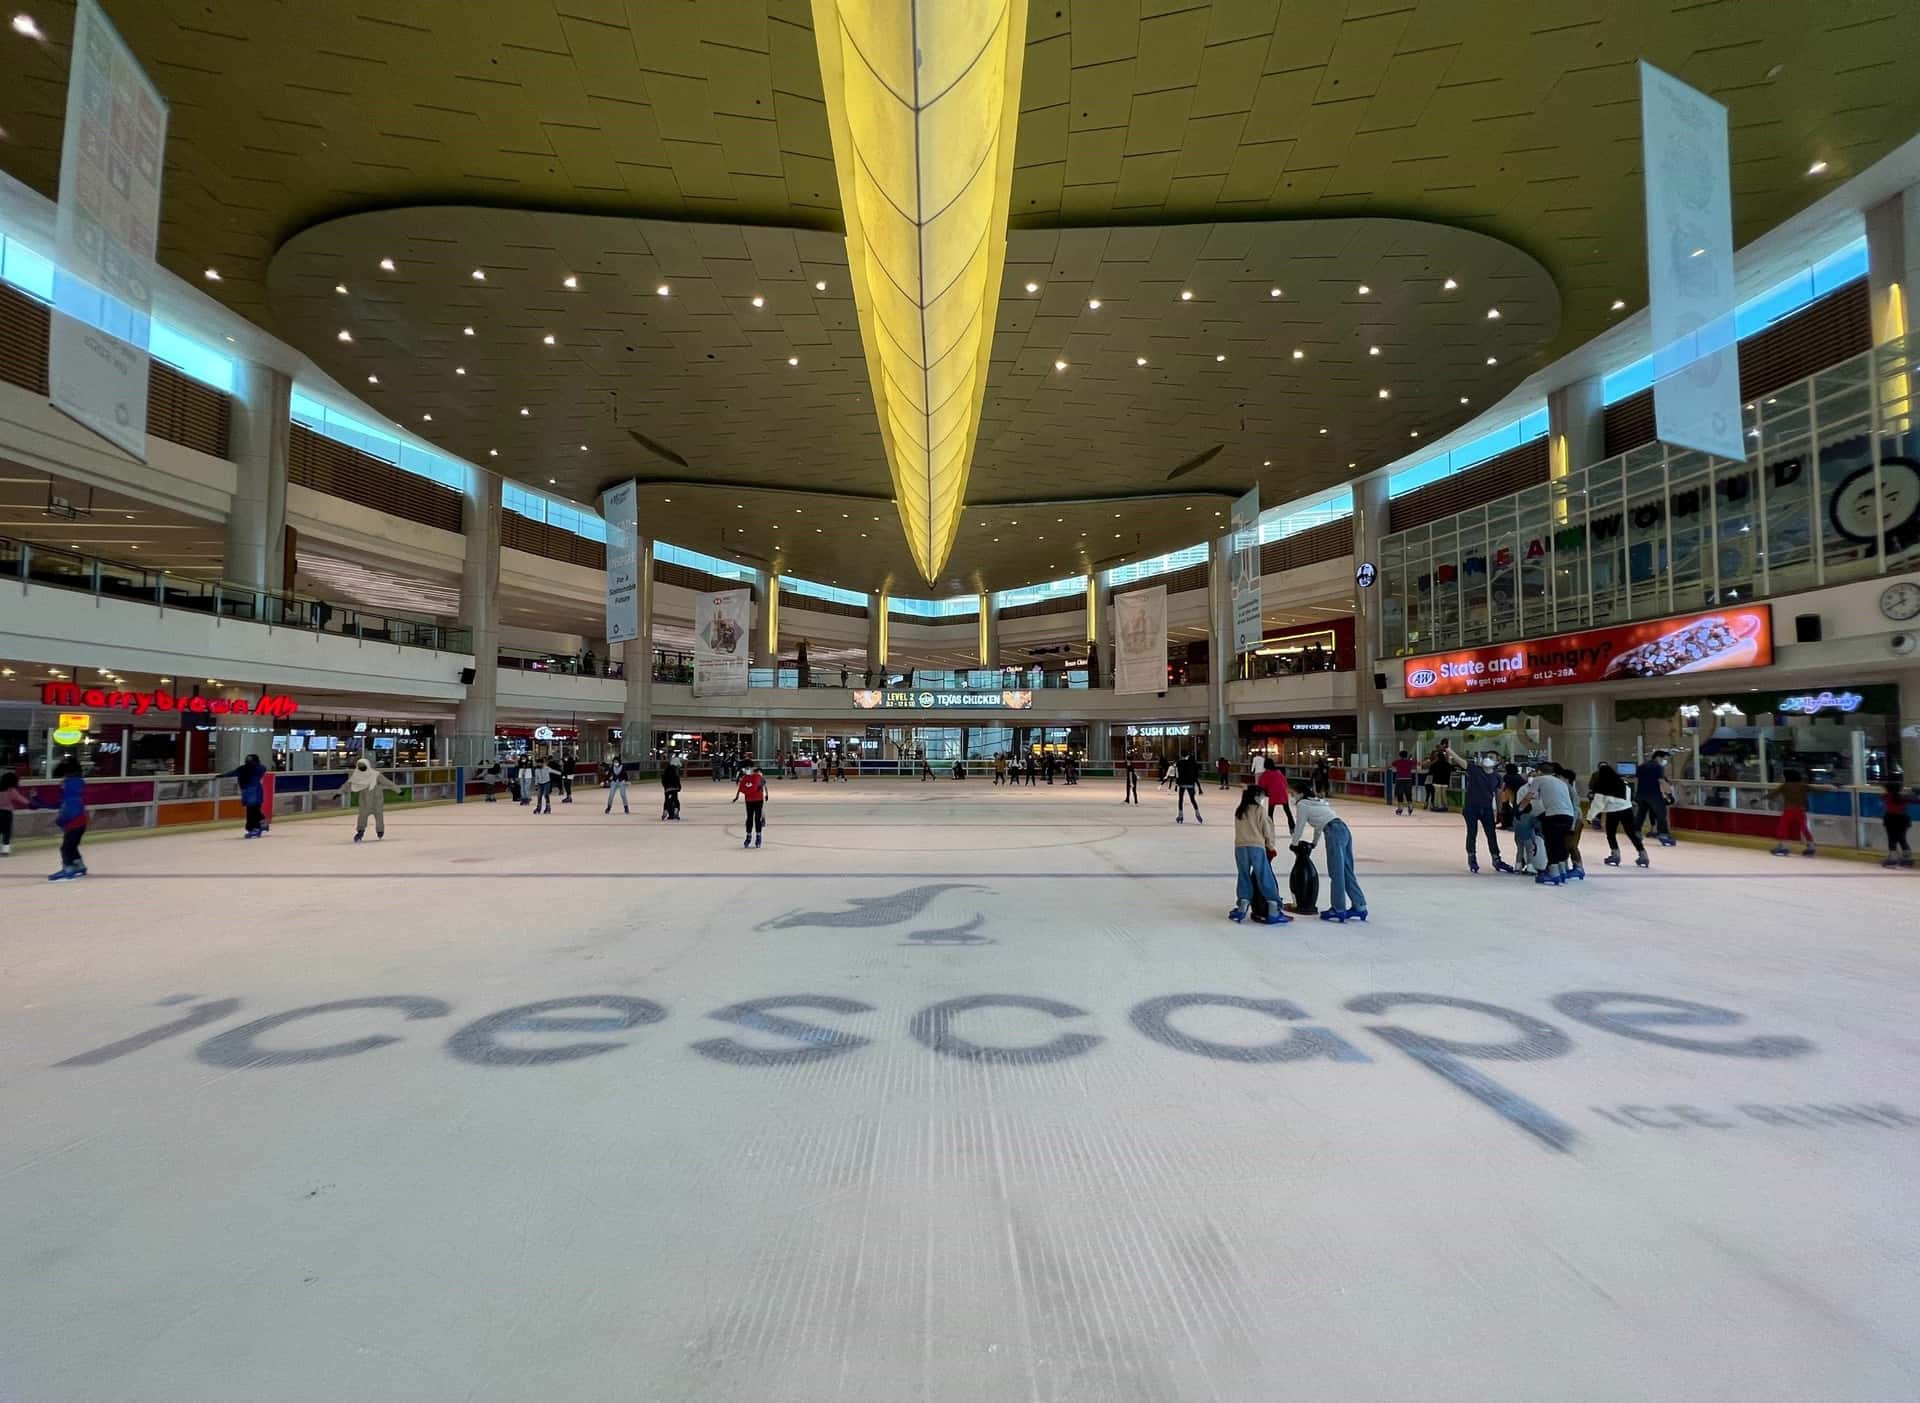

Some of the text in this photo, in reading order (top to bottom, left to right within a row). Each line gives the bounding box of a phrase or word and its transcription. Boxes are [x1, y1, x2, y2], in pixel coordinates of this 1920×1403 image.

[1440, 641, 1613, 678] Skate and hungry?
[887, 692, 908, 701] LEVEL
[937, 695, 961, 705] TEXAS
[962, 695, 1001, 706] CHICKEN
[1140, 725, 1190, 736] SUSHI KING
[51, 991, 1818, 1153] icescape
